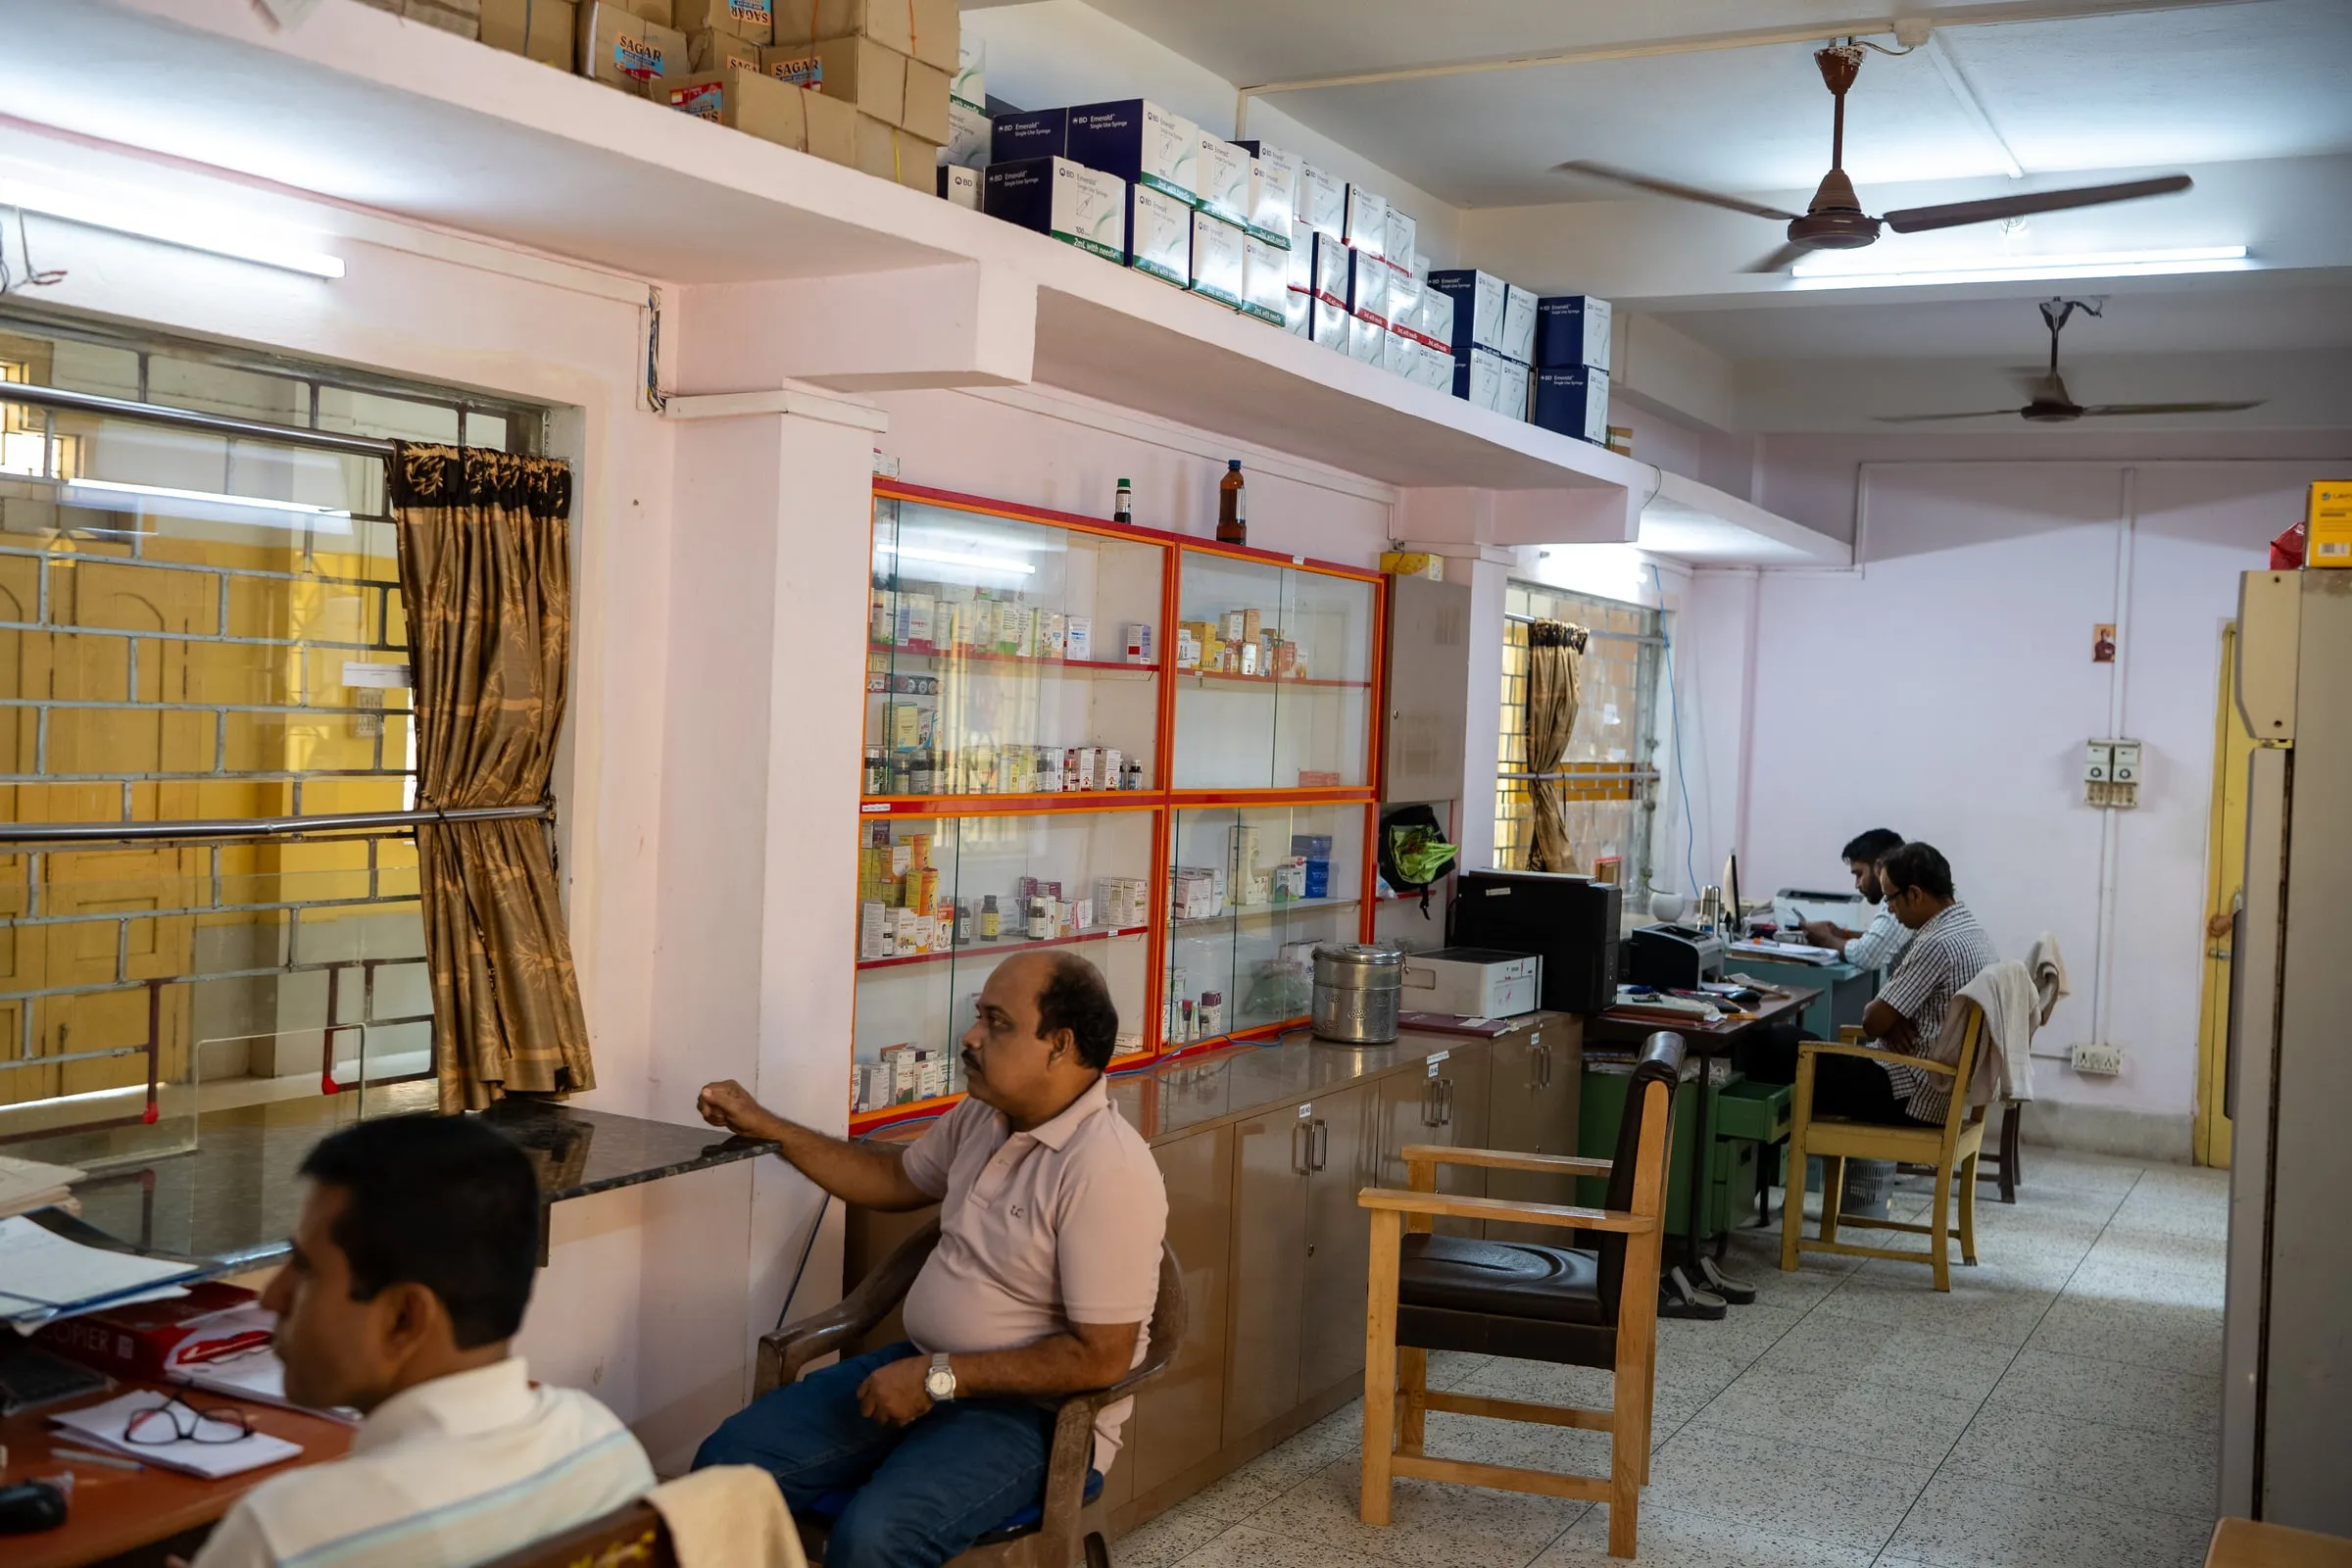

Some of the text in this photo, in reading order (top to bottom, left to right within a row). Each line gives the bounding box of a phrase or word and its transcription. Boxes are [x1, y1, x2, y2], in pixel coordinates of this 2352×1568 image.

[731, 6, 768, 24] SAGAR
[619, 35, 662, 62] SAGAR
[775, 58, 819, 76] SAGAR
[1090, 114, 1113, 122] Emerald
[994, 173, 1003, 182] BD
[1066, 170, 1075, 178] BD
[962, 177, 973, 187] BD
[1075, 226, 1085, 235] 100
[1074, 237, 1086, 249] 2mL
[1086, 242, 1099, 253] with
